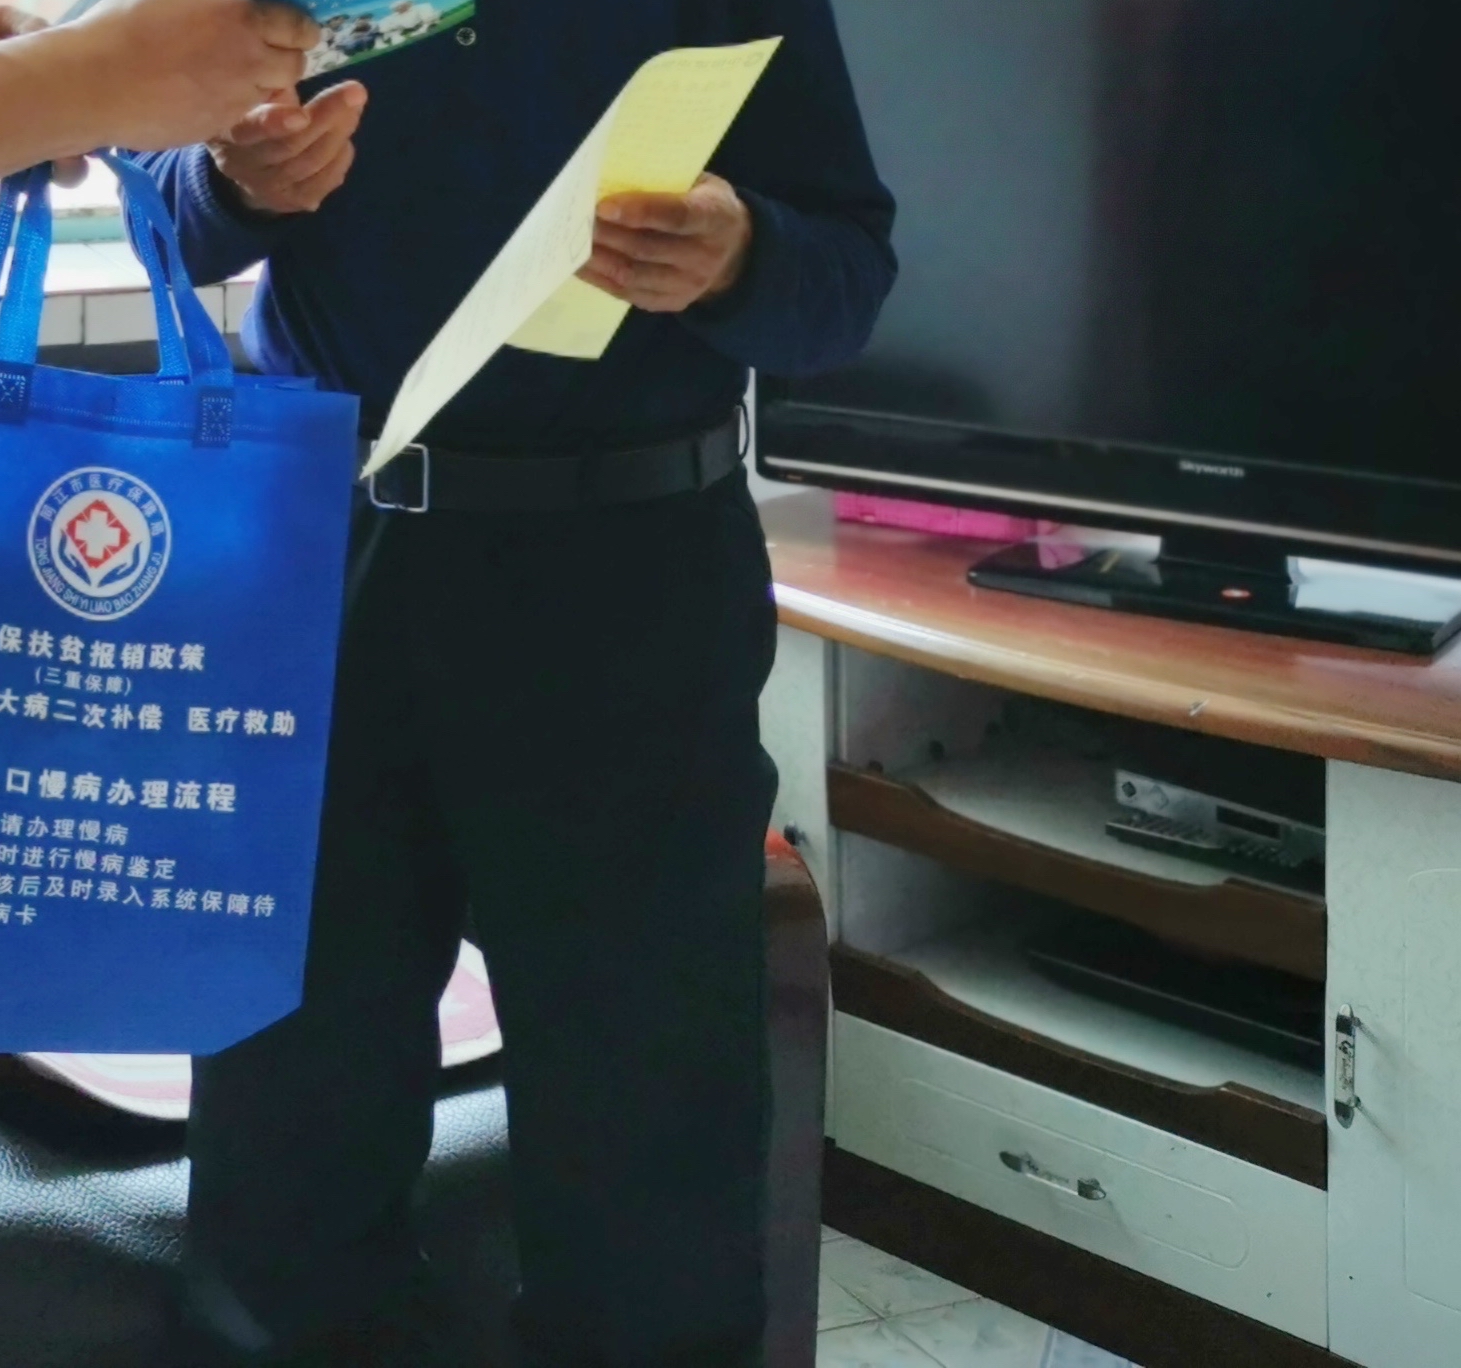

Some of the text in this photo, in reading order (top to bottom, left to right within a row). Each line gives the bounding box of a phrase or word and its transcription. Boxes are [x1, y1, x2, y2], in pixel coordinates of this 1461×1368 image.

[35, 537, 163, 613] TONG JIANG SHI YI LIAO BAO ZHANG JU
[187, 706, 296, 736] 医疗救助
